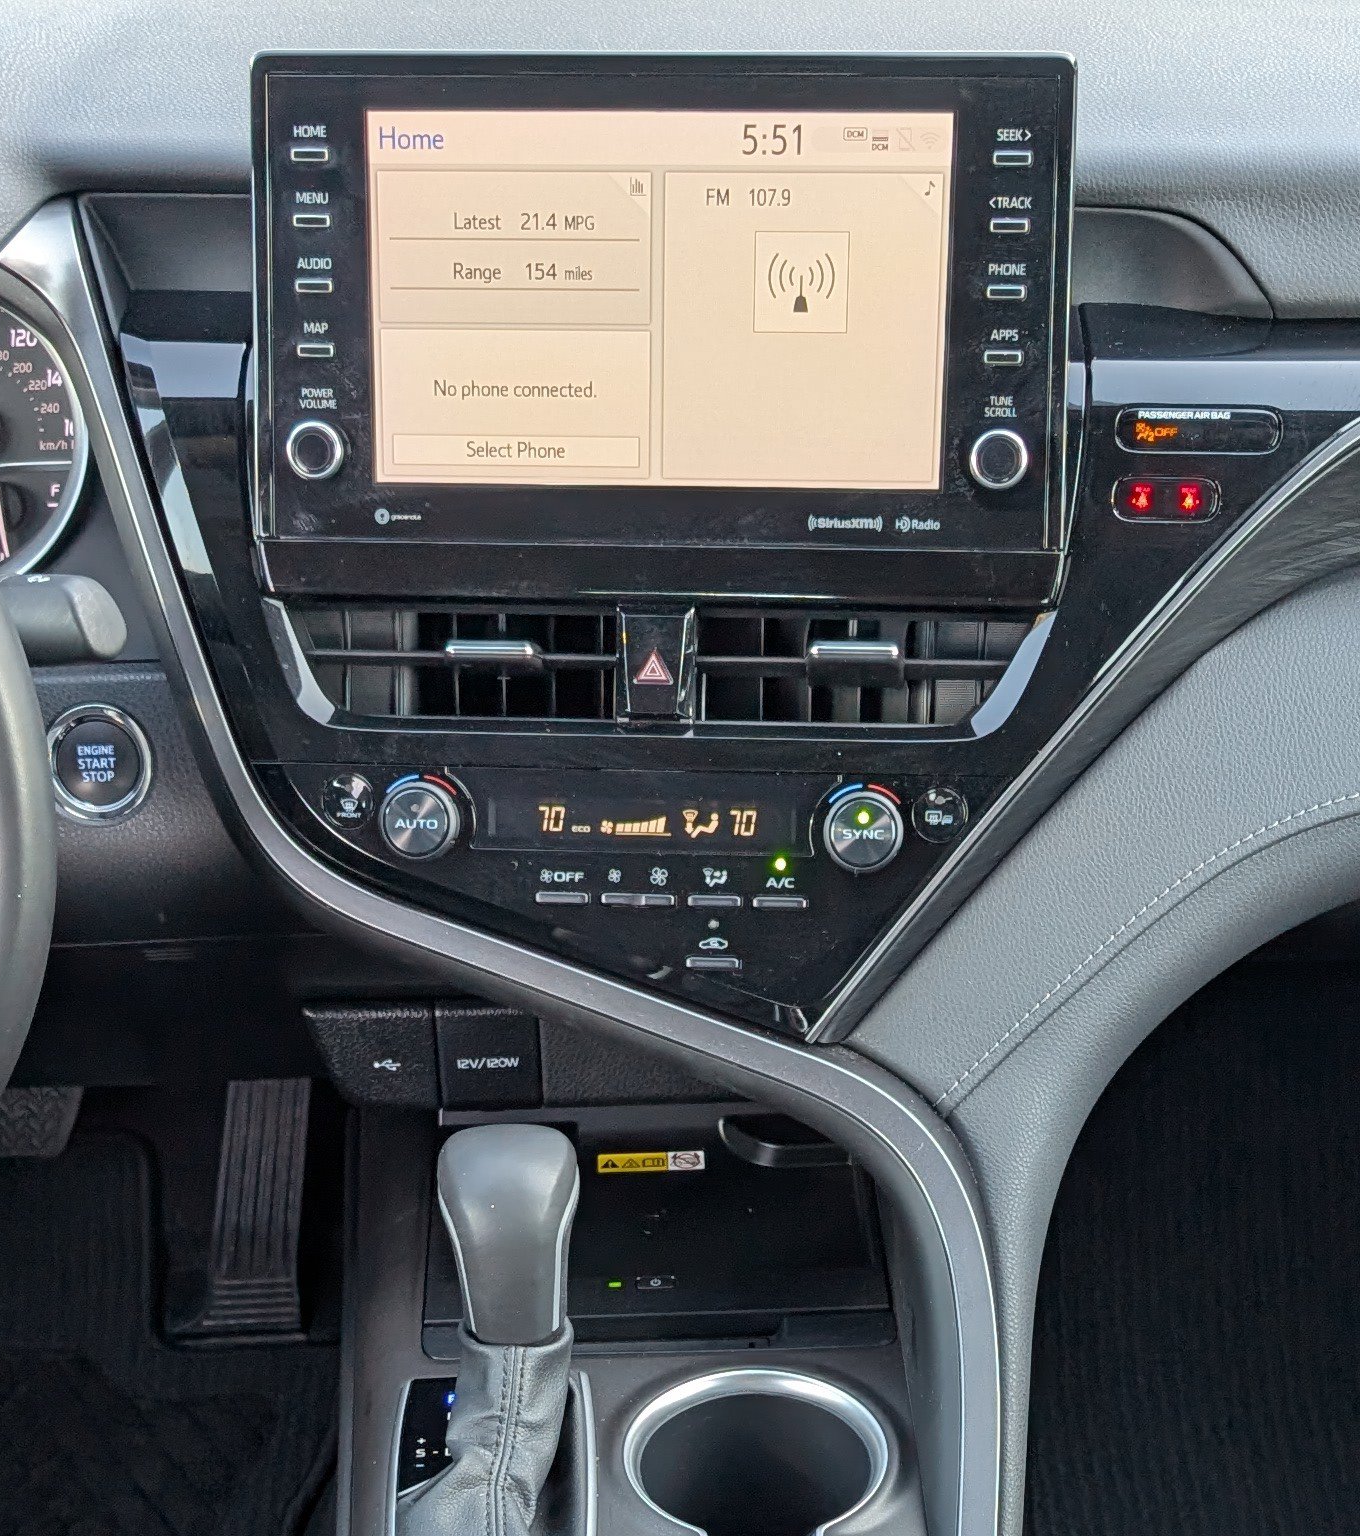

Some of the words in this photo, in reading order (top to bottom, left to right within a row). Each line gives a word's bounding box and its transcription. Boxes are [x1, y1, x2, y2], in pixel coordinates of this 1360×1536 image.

[293, 125, 327, 138] HOME
[846, 130, 864, 139] DCM
[378, 126, 444, 150] Home
[741, 124, 803, 156] 5:51
[871, 143, 889, 151] DCM
[295, 191, 329, 205] MENU
[705, 188, 730, 207] FM
[749, 188, 791, 207] 107.9
[453, 212, 502, 231] Latest
[520, 212, 557, 231] 21.4
[564, 215, 595, 231] MPG
[297, 257, 332, 270] AUDIO
[987, 263, 1026, 276] PHONE
[453, 262, 502, 283] Range
[525, 262, 557, 281] 154
[564, 266, 593, 281] miles
[303, 322, 328, 334] MAP
[10, 328, 38, 347] 120
[990, 329, 1019, 341] APPS
[13, 362, 32, 374] 200
[47, 369, 63, 388] 14
[28, 380, 47, 391] 220
[433, 380, 457, 397] No
[461, 380, 509, 400] phone
[513, 380, 597, 398] connected.
[301, 387, 333, 398] POWER
[299, 399, 338, 410] VOLUME
[990, 395, 1014, 406] TUNE
[40, 402, 60, 414] 240
[984, 407, 1018, 418] SCROLL
[1137, 411, 1193, 419] PASSENGER
[1154, 427, 1178, 437] OFF
[39, 440, 68, 451] km/h
[466, 441, 512, 458] Select
[517, 441, 566, 459] Phone
[50, 484, 60, 497] F
[911, 518, 941, 531] Radio
[77, 745, 114, 756] ENGINE
[77, 757, 116, 769] START
[82, 770, 115, 783] STOP
[394, 818, 438, 830] AUTO
[538, 806, 566, 832] 70
[729, 810, 757, 836] 70
[842, 828, 885, 841] SYNC
[553, 871, 585, 883] OFF
[765, 877, 795, 889] A/C
[456, 1057, 520, 1069] 12V/120W
[415, 1448, 426, 1458] S
